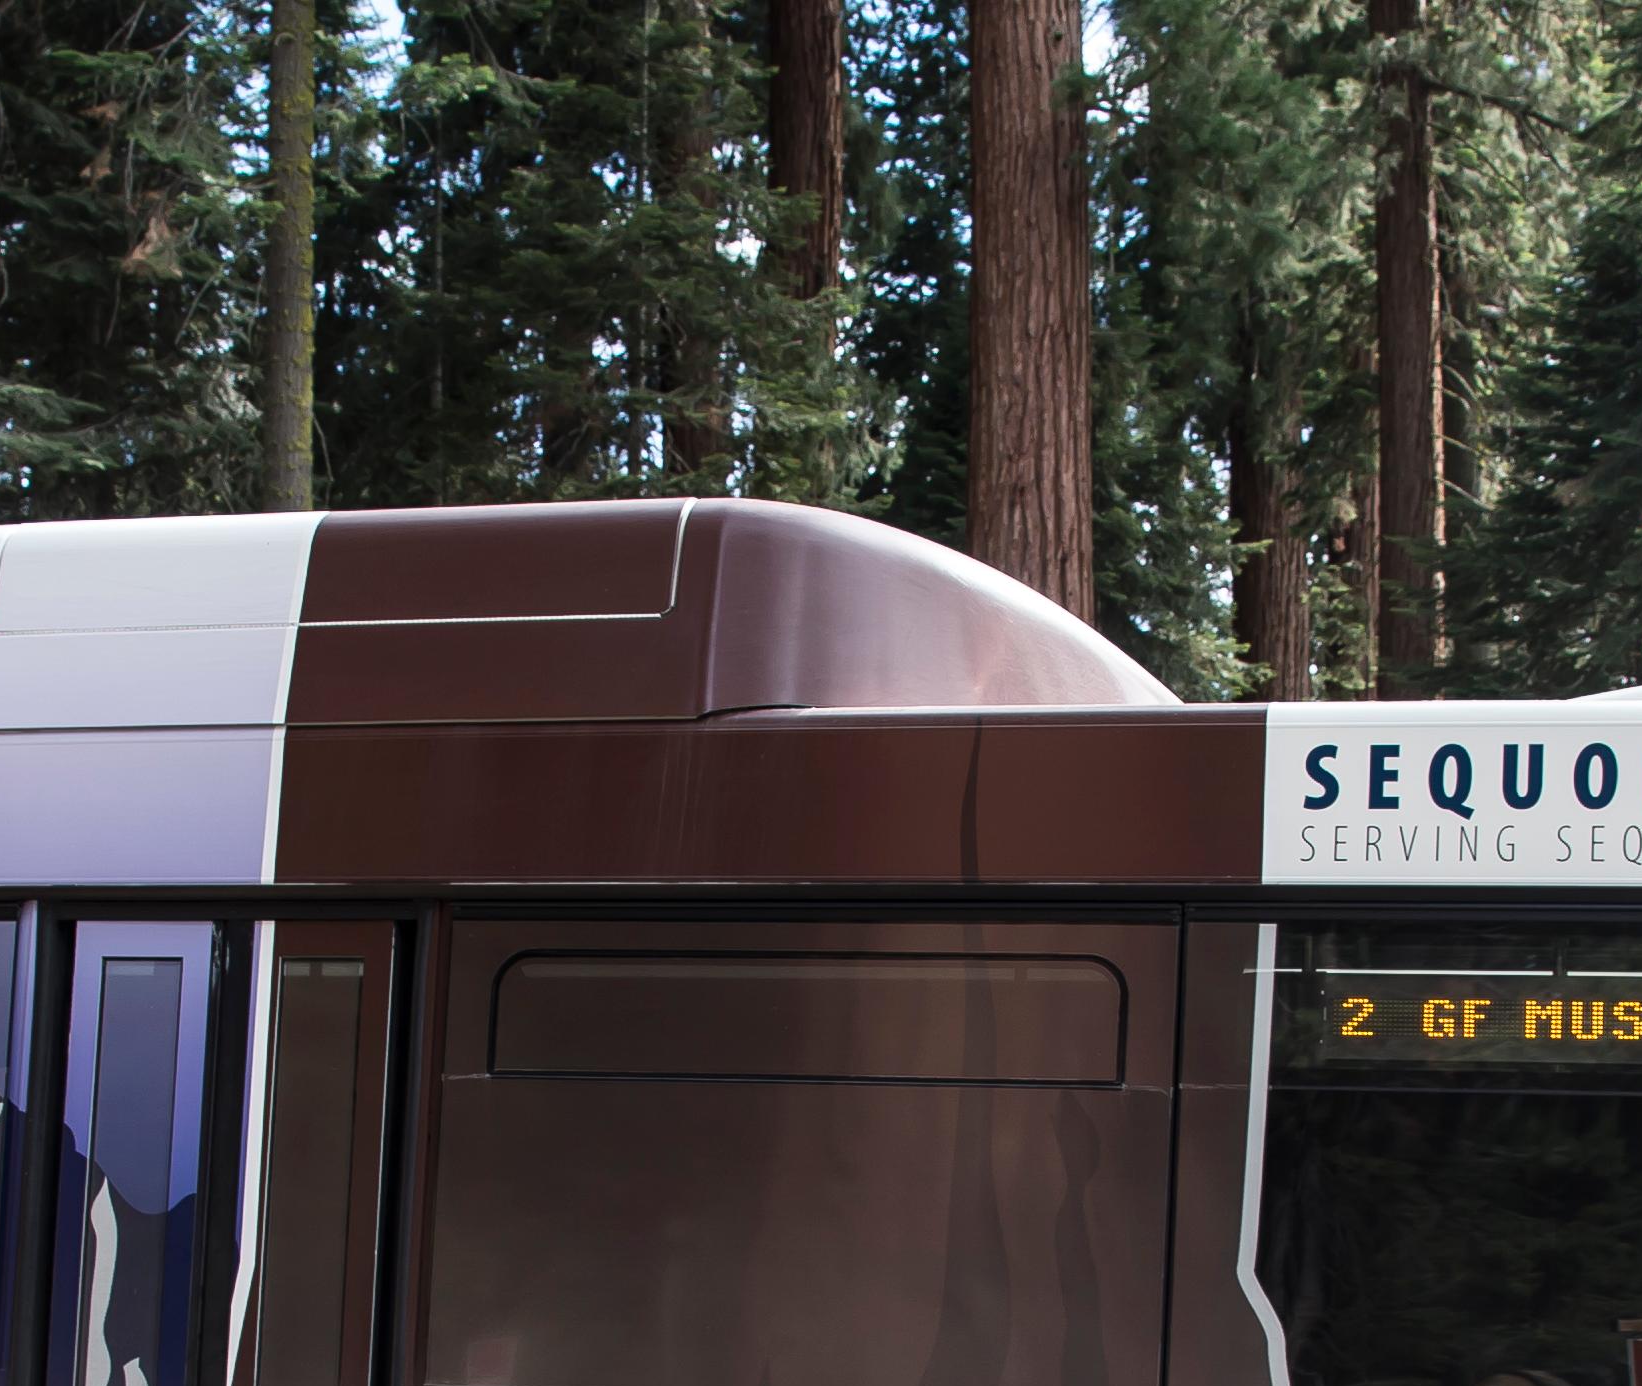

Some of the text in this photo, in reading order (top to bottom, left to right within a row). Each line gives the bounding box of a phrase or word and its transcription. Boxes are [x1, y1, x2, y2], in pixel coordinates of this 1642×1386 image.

[1300, 825, 1516, 862] SERVING
[1341, 998, 1375, 1036] 2
[1421, 999, 1492, 1039] GF
